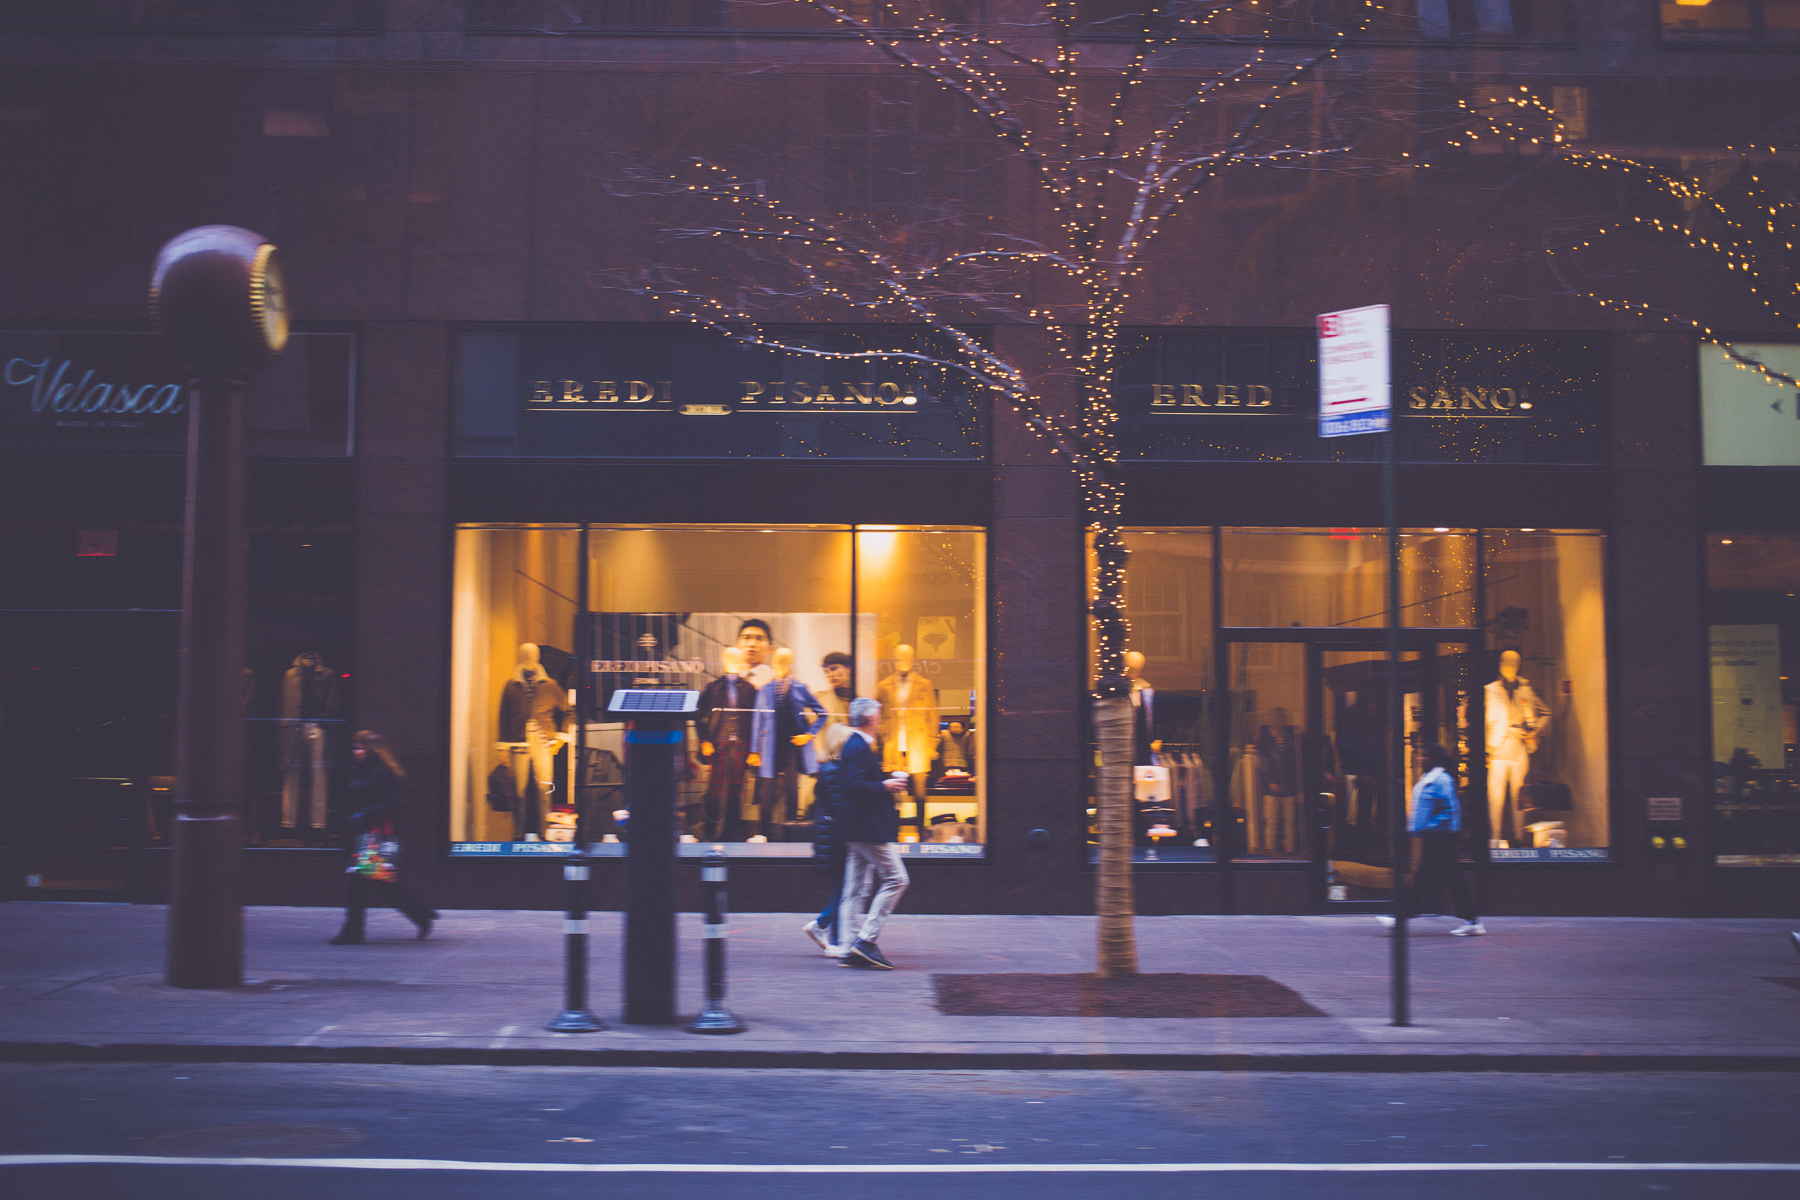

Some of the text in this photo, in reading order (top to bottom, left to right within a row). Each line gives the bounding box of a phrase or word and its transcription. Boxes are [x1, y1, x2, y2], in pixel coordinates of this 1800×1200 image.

[4, 357, 184, 414] Velasca
[528, 380, 673, 403] EREDI
[1151, 384, 1517, 410] ERED SANO
